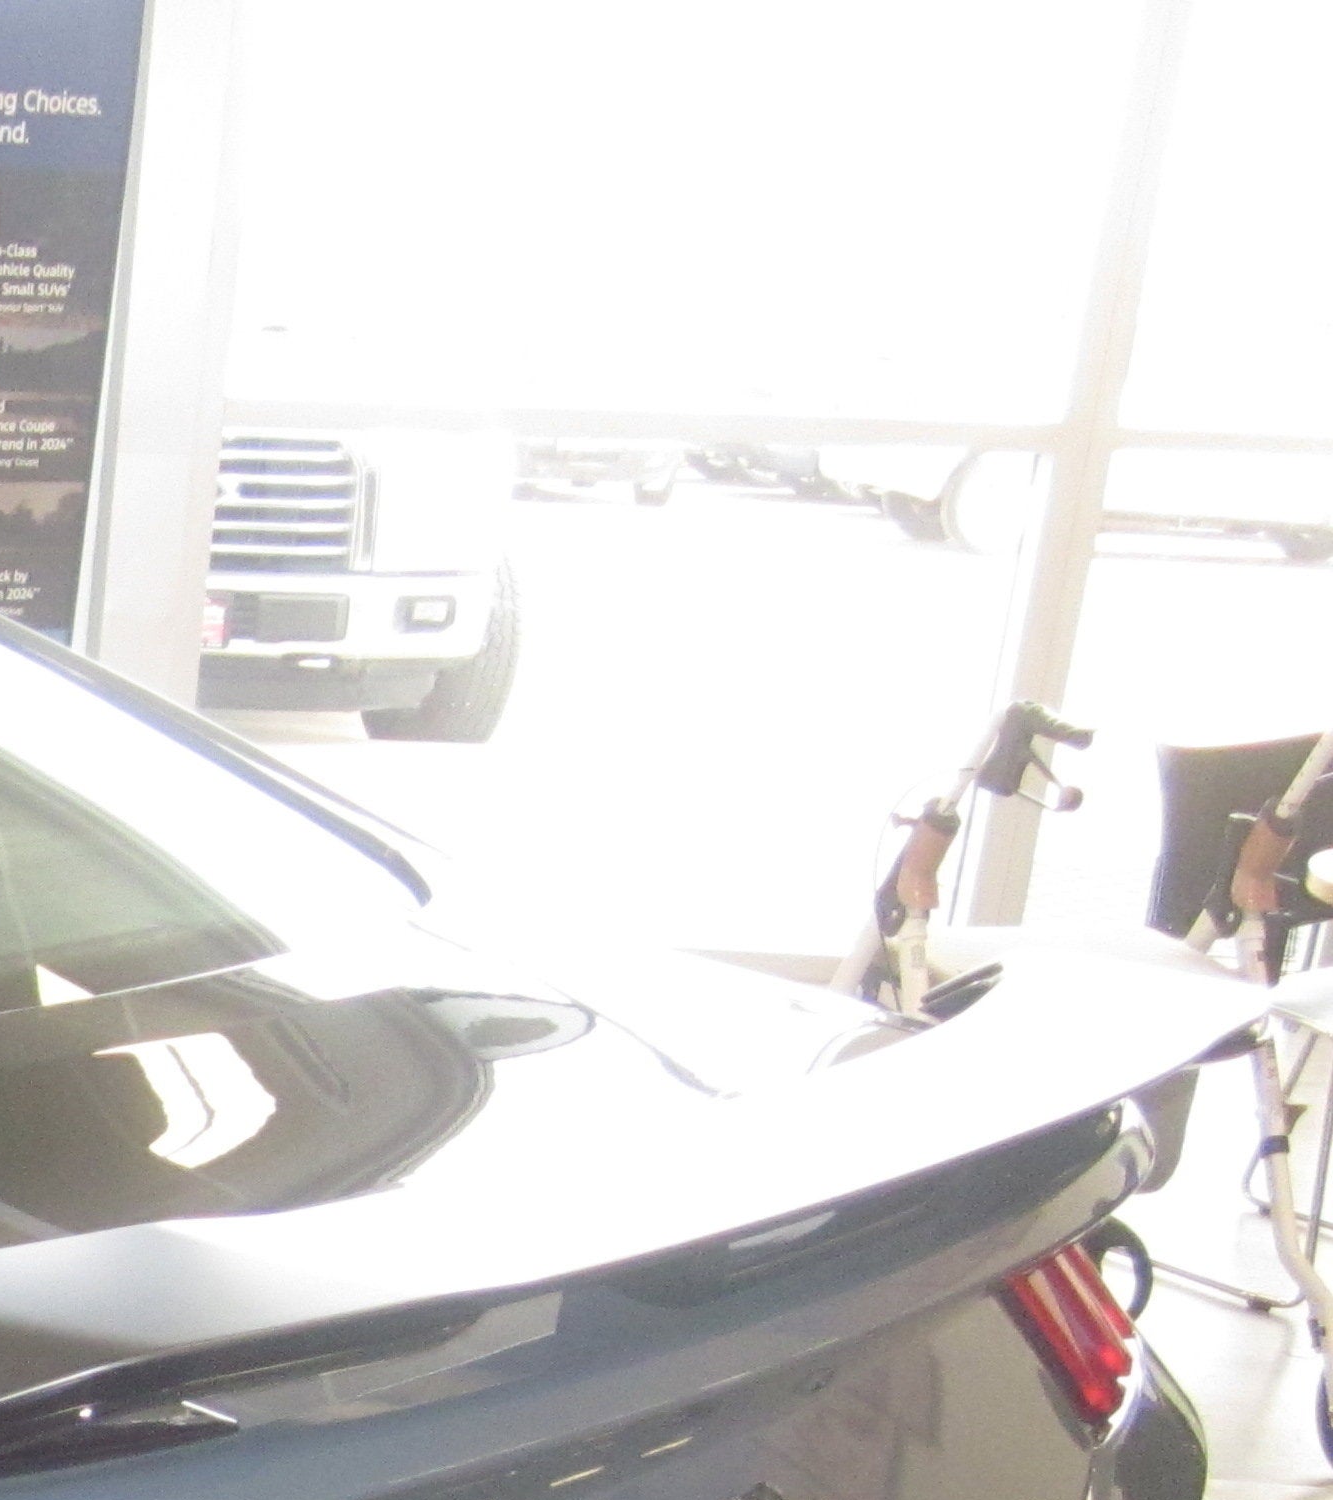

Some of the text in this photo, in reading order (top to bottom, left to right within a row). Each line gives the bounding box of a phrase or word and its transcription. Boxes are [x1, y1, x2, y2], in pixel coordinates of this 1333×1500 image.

[23, 89, 102, 116] Choices.
[33, 263, 75, 279] Quality
[1, 281, 34, 296] Small
[19, 419, 55, 435] Coupe
[26, 438, 38, 451] in
[14, 569, 29, 585] by
